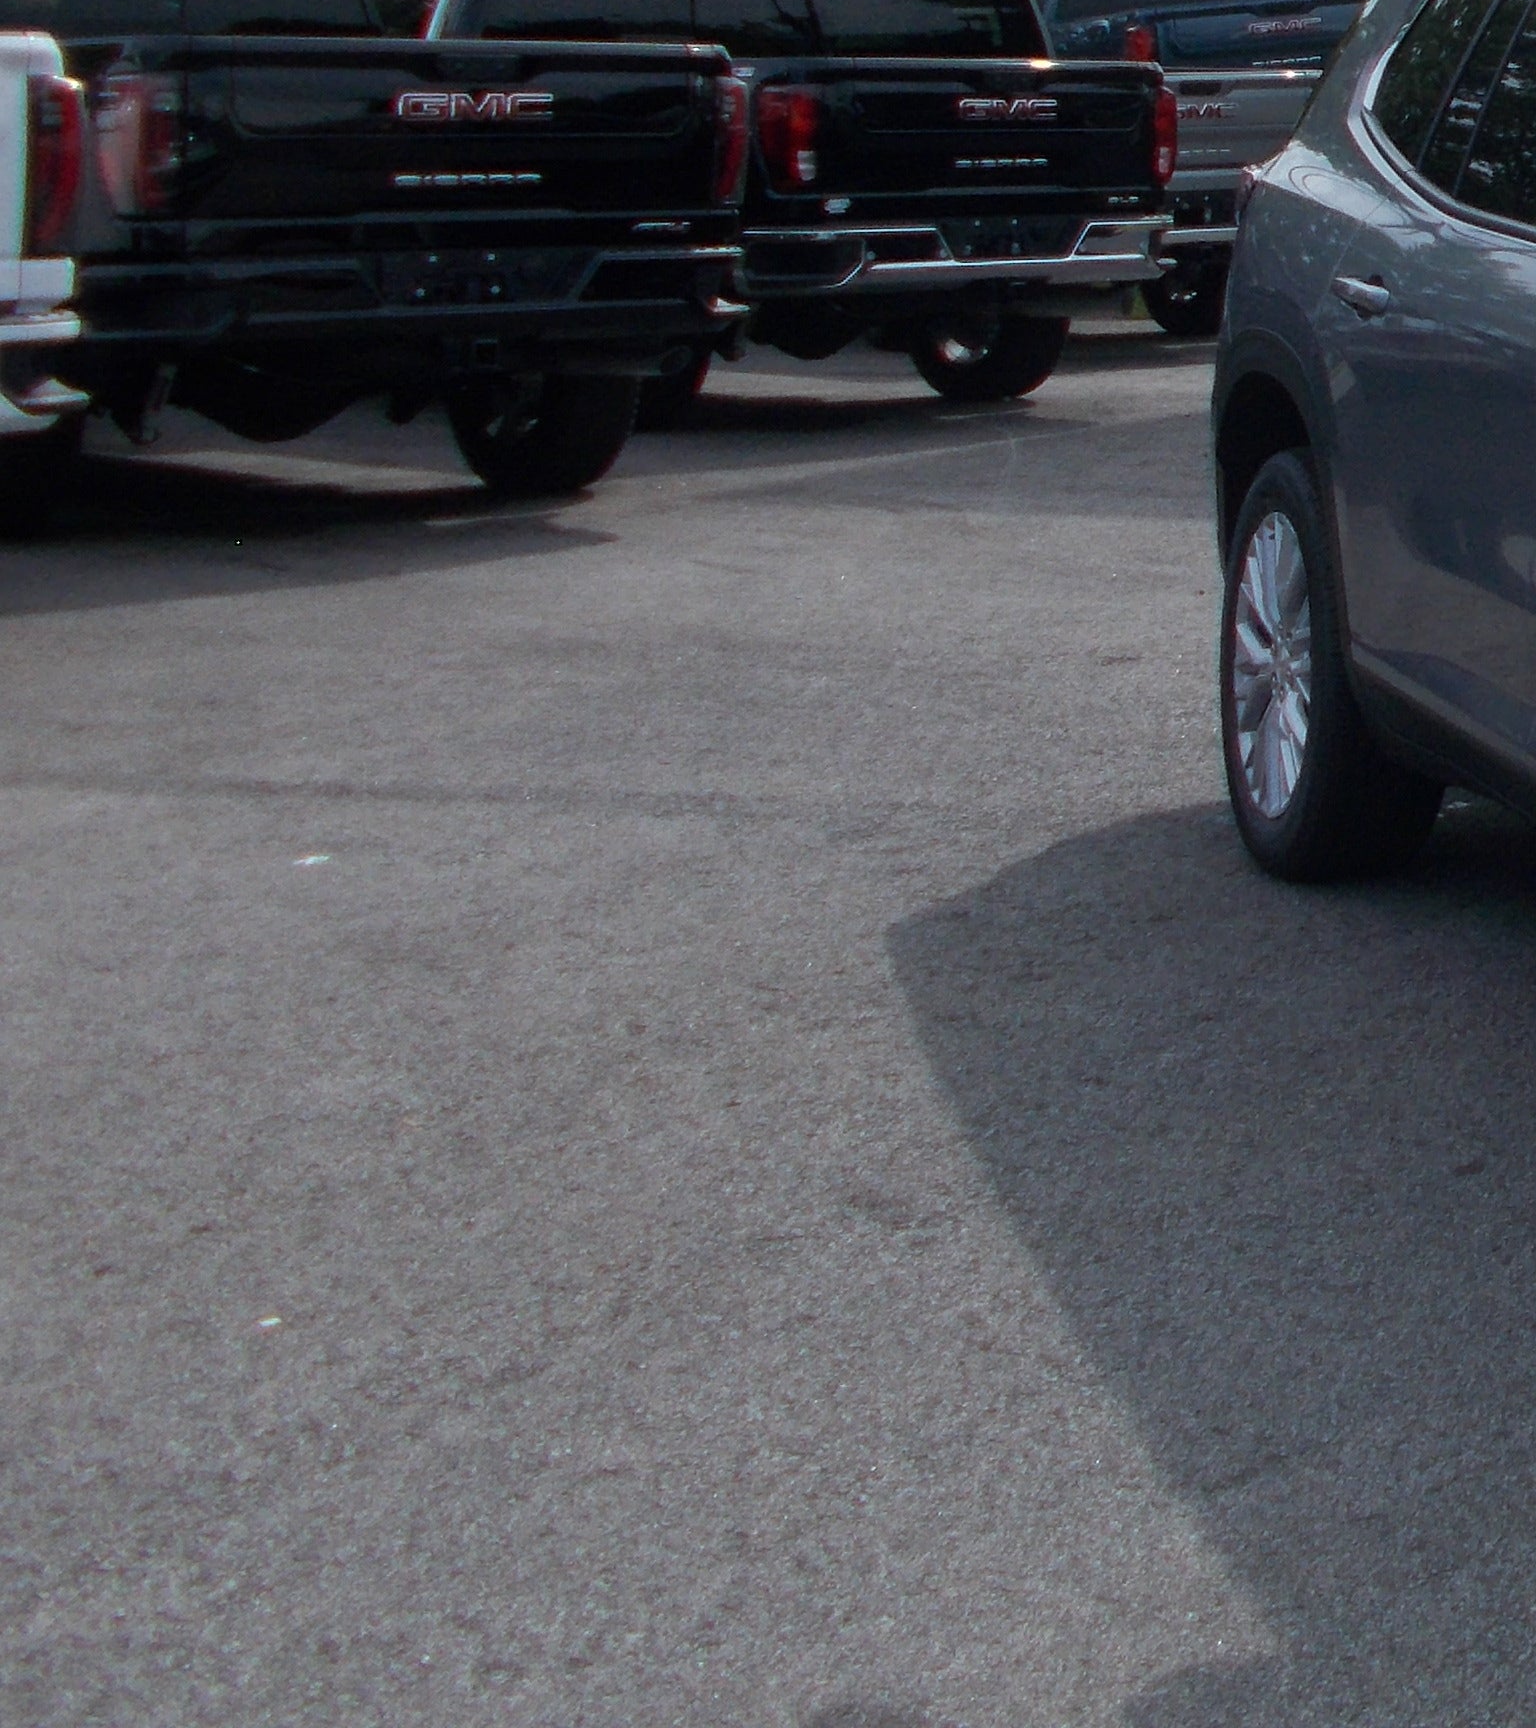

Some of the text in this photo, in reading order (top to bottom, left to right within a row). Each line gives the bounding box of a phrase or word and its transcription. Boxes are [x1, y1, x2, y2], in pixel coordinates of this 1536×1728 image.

[1248, 17, 1322, 35] GMC
[397, 91, 553, 121] GMC
[958, 97, 1058, 120] GMC
